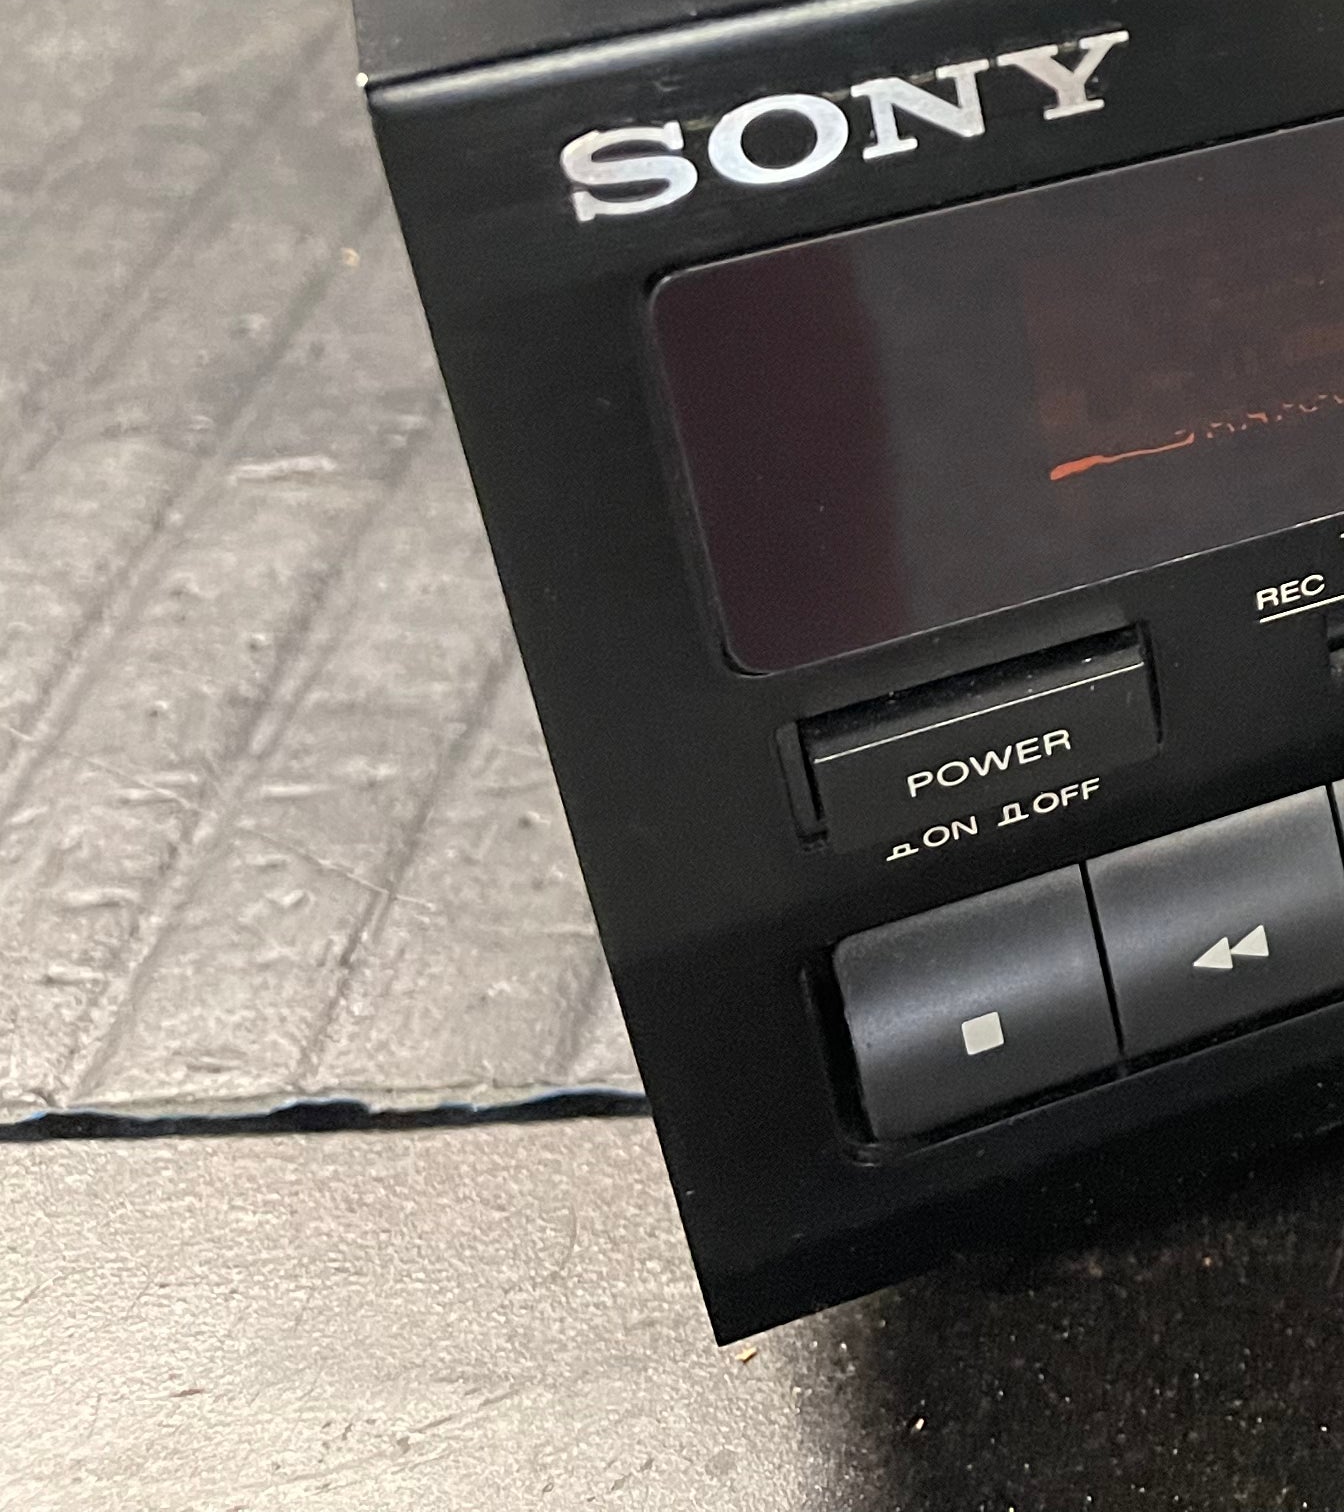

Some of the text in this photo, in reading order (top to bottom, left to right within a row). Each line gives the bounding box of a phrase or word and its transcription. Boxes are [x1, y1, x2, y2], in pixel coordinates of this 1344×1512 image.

[560, 31, 1129, 222] SONY
[1255, 574, 1325, 611] REC
[906, 728, 1072, 799] POWER
[922, 776, 1101, 848] ON OFF
